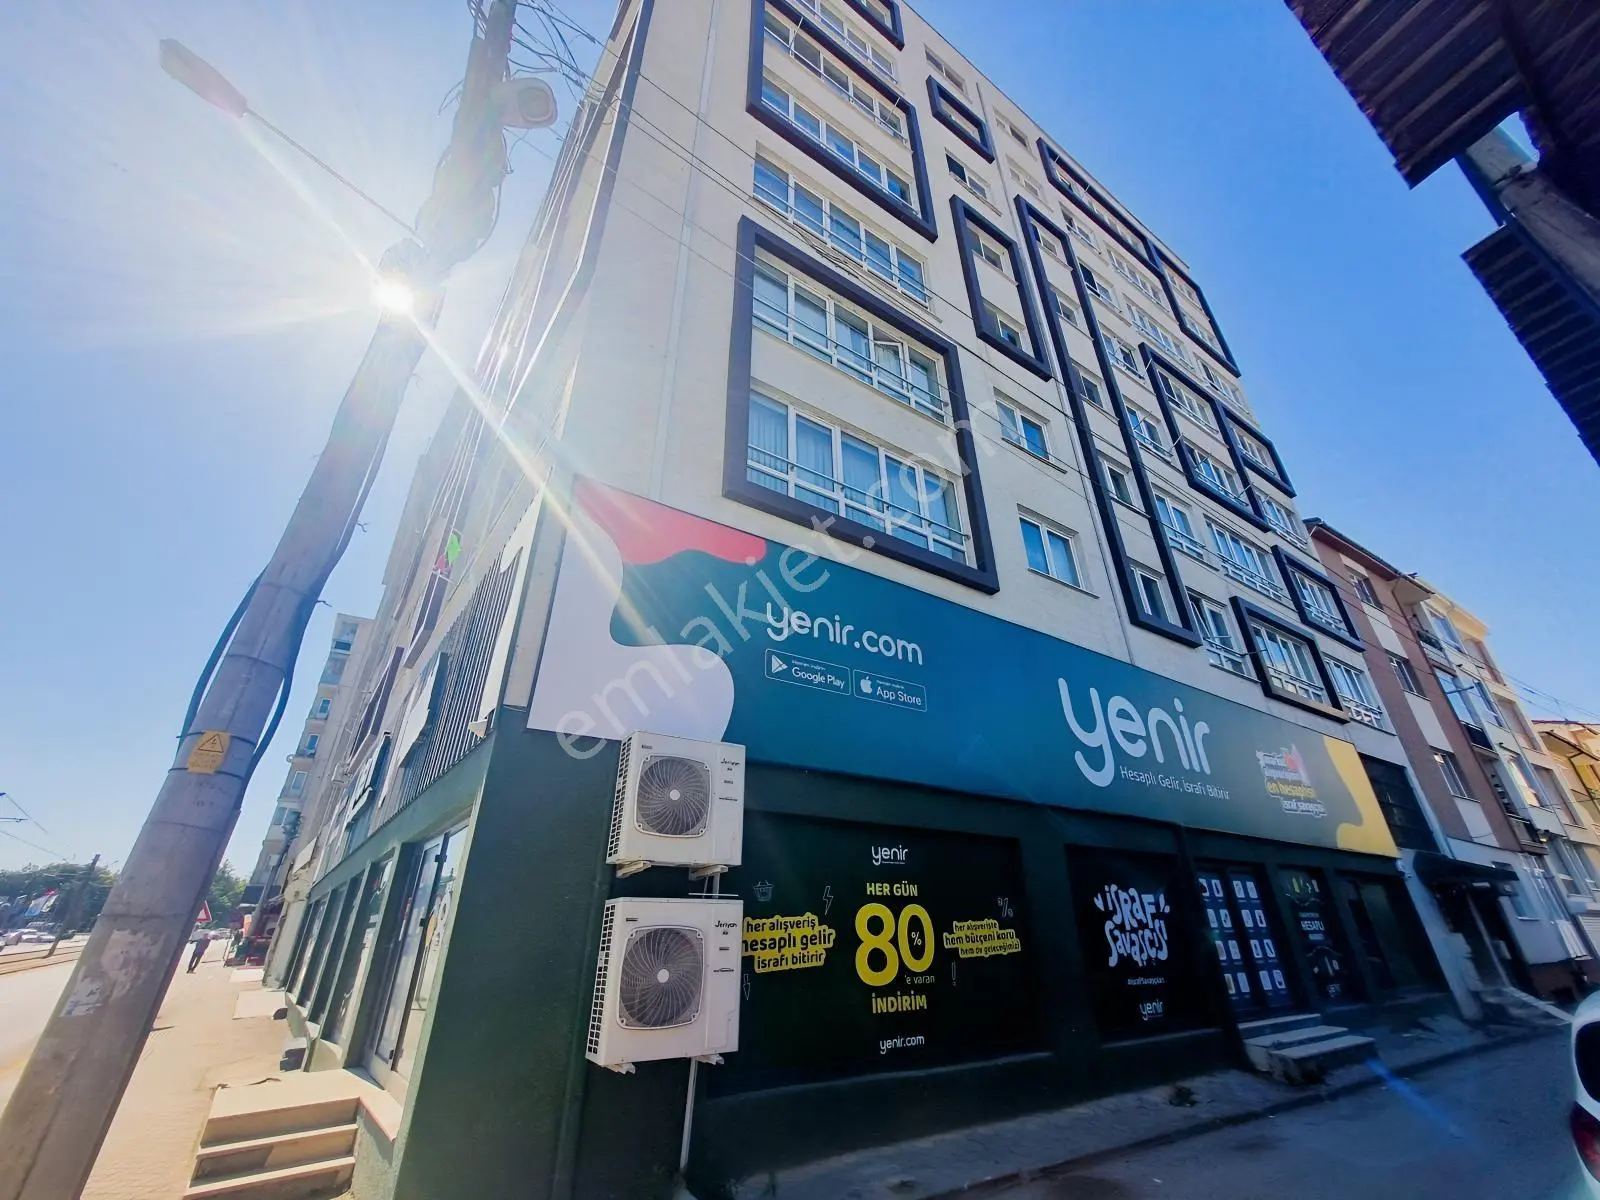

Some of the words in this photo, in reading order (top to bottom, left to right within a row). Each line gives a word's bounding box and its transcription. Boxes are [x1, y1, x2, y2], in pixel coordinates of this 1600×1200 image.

[766, 601, 923, 665] yenir.com
[791, 667, 825, 684] Google
[827, 674, 845, 689] Play
[876, 686, 896, 700] App
[898, 691, 922, 706] Store
[1058, 677, 1211, 788] yenir
[1120, 765, 1157, 787] Hesaplı
[871, 844, 909, 866] yenir
[866, 882, 890, 896] HER
[893, 881, 918, 897] GÜN
[746, 921, 767, 934] her
[768, 917, 816, 932] alışveriş
[800, 928, 834, 951] gelir
[855, 903, 935, 986] 80
[911, 931, 922, 947] %
[757, 954, 789, 969] israfı
[791, 950, 824, 965] bitirir
[913, 974, 935, 984] varan
[871, 990, 928, 1014] İNDİRİM
[879, 1034, 925, 1055] yenir.com
